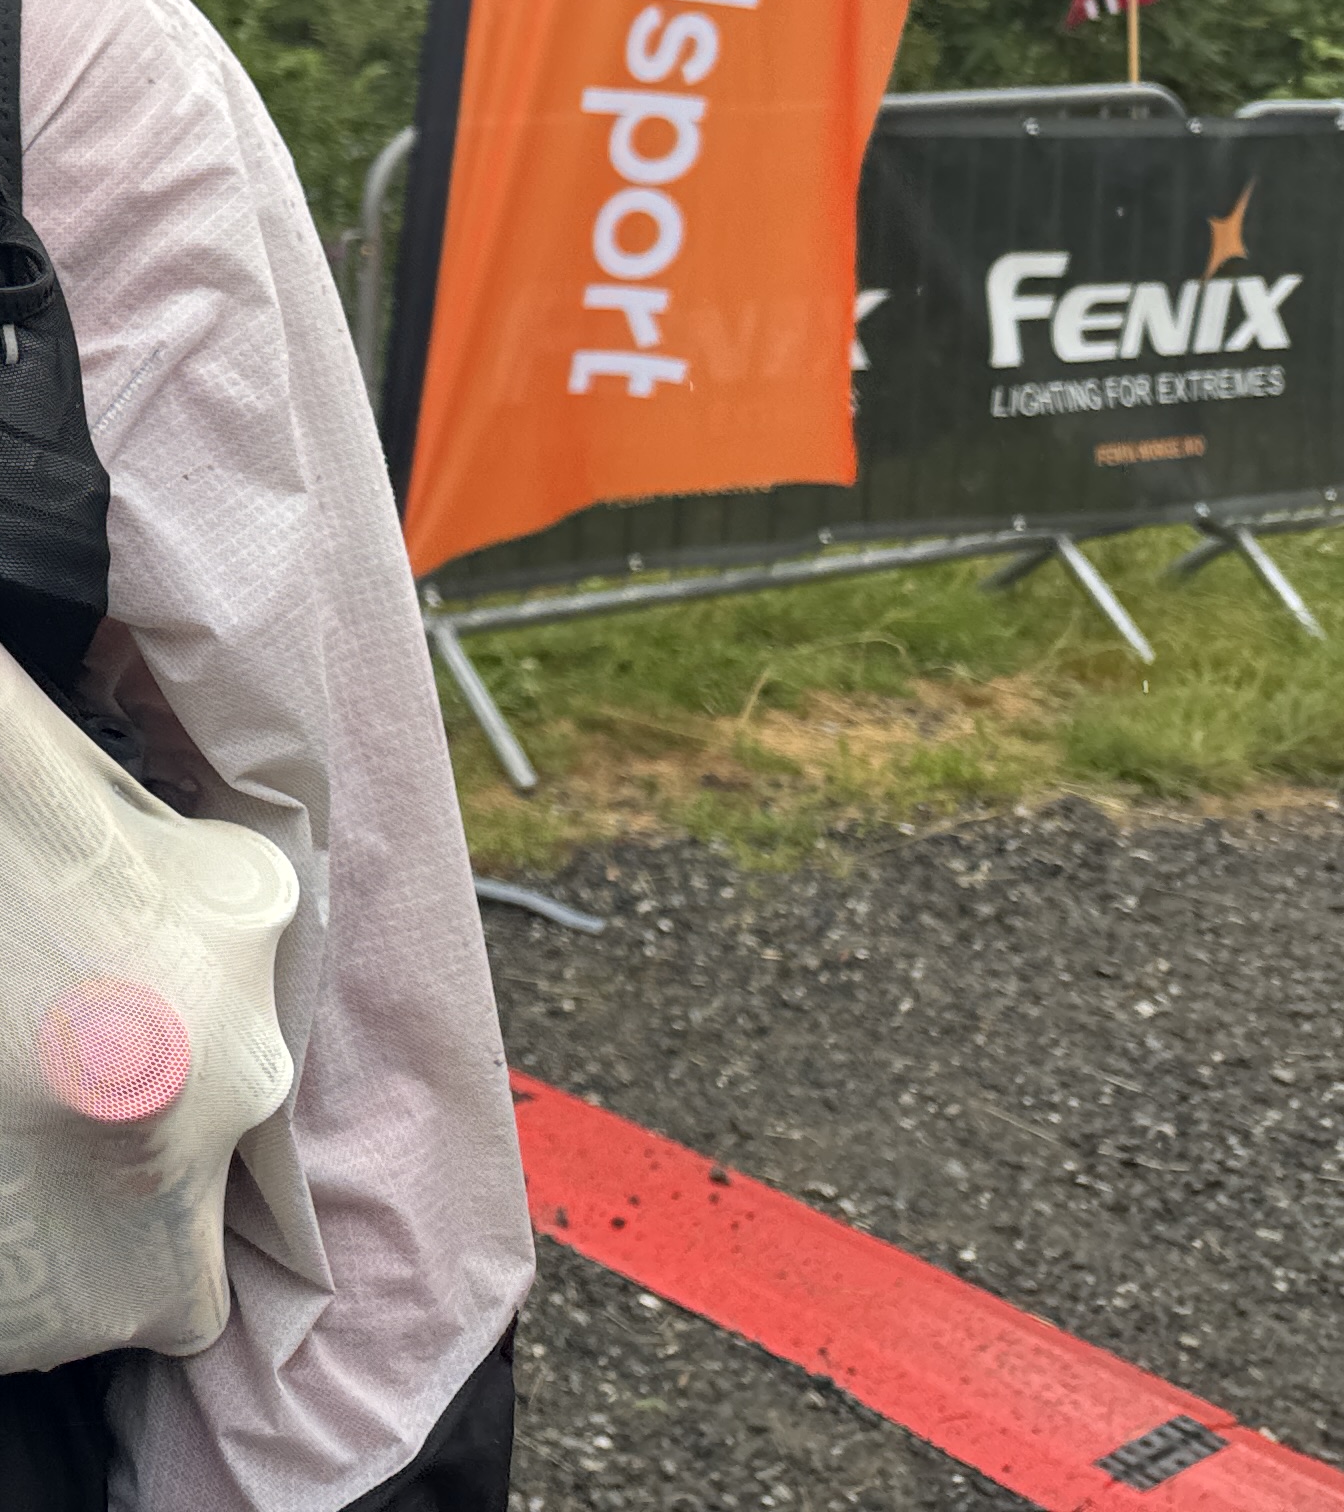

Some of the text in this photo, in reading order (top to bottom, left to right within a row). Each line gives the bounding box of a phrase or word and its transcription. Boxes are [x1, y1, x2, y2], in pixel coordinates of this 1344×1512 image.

[986, 251, 1303, 369] FENIX
[991, 365, 1285, 418] LIGHTING FOR EXTREMES
